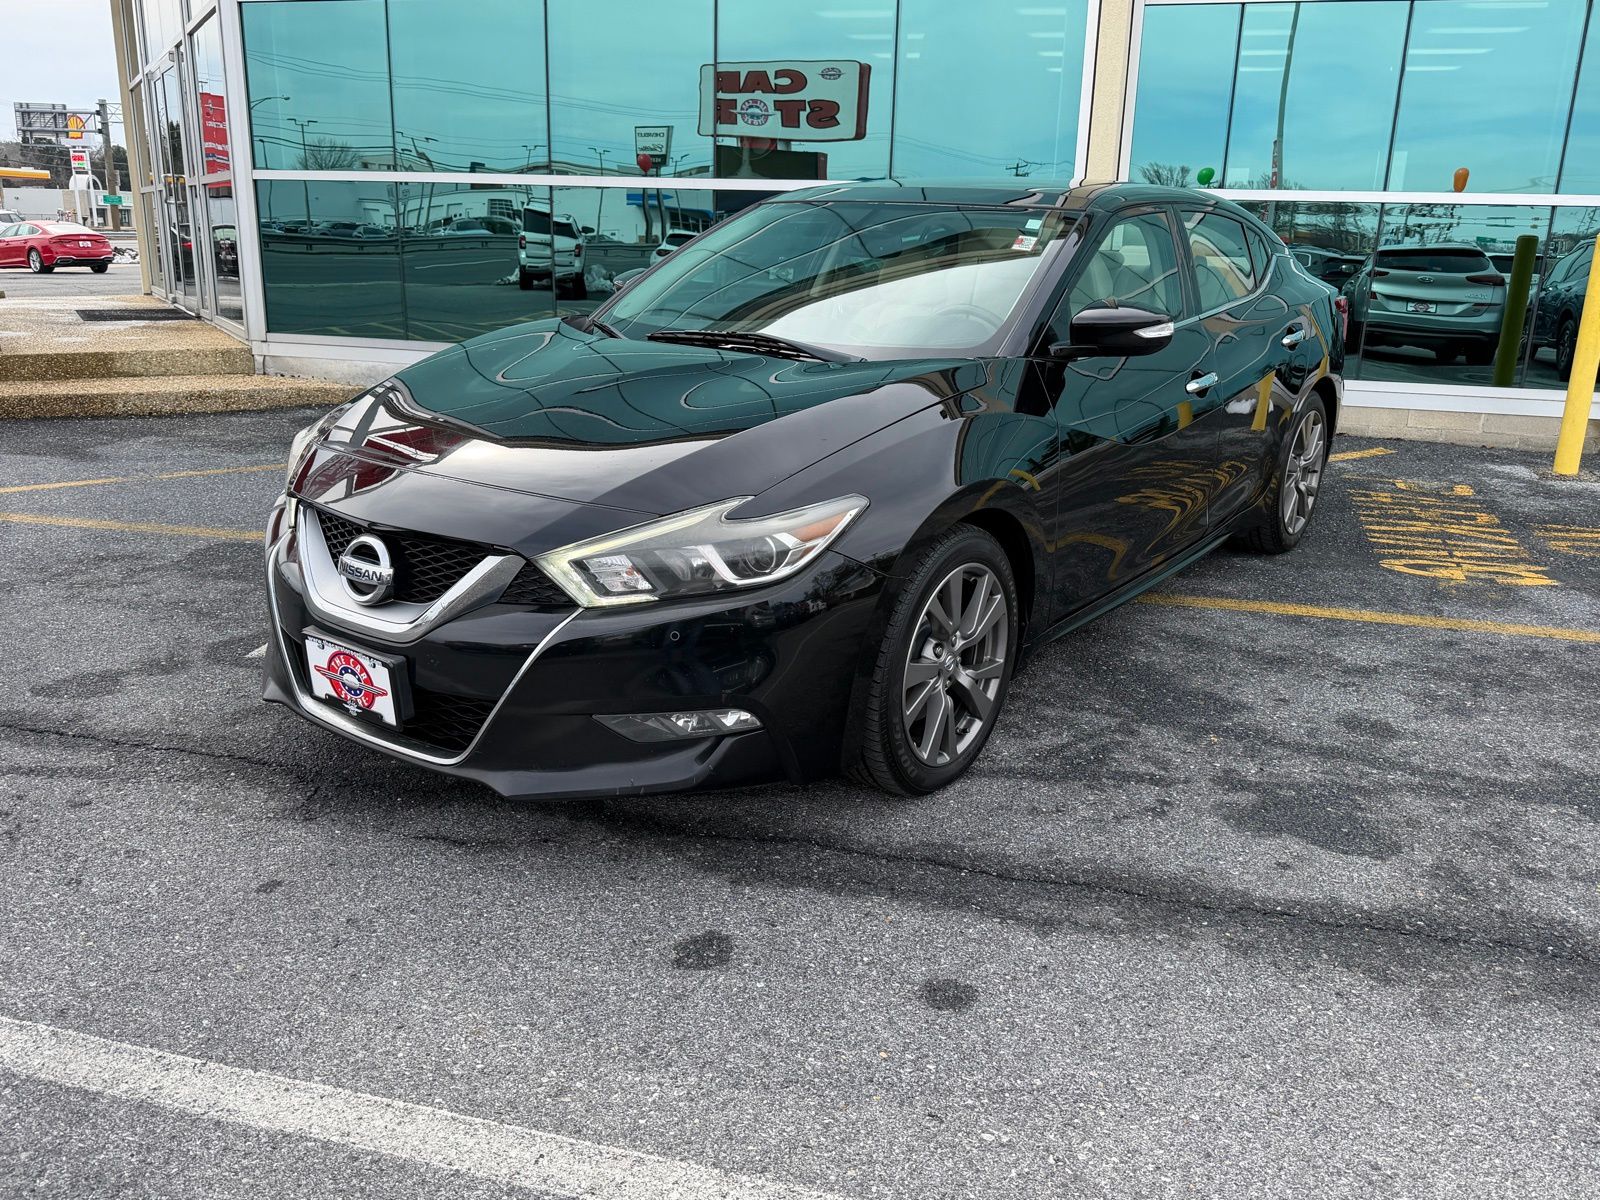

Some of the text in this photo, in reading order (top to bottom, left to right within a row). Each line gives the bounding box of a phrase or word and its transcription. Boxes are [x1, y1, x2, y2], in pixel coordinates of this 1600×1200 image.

[339, 560, 383, 582] NISSAN
[331, 655, 368, 681] THE CAR
